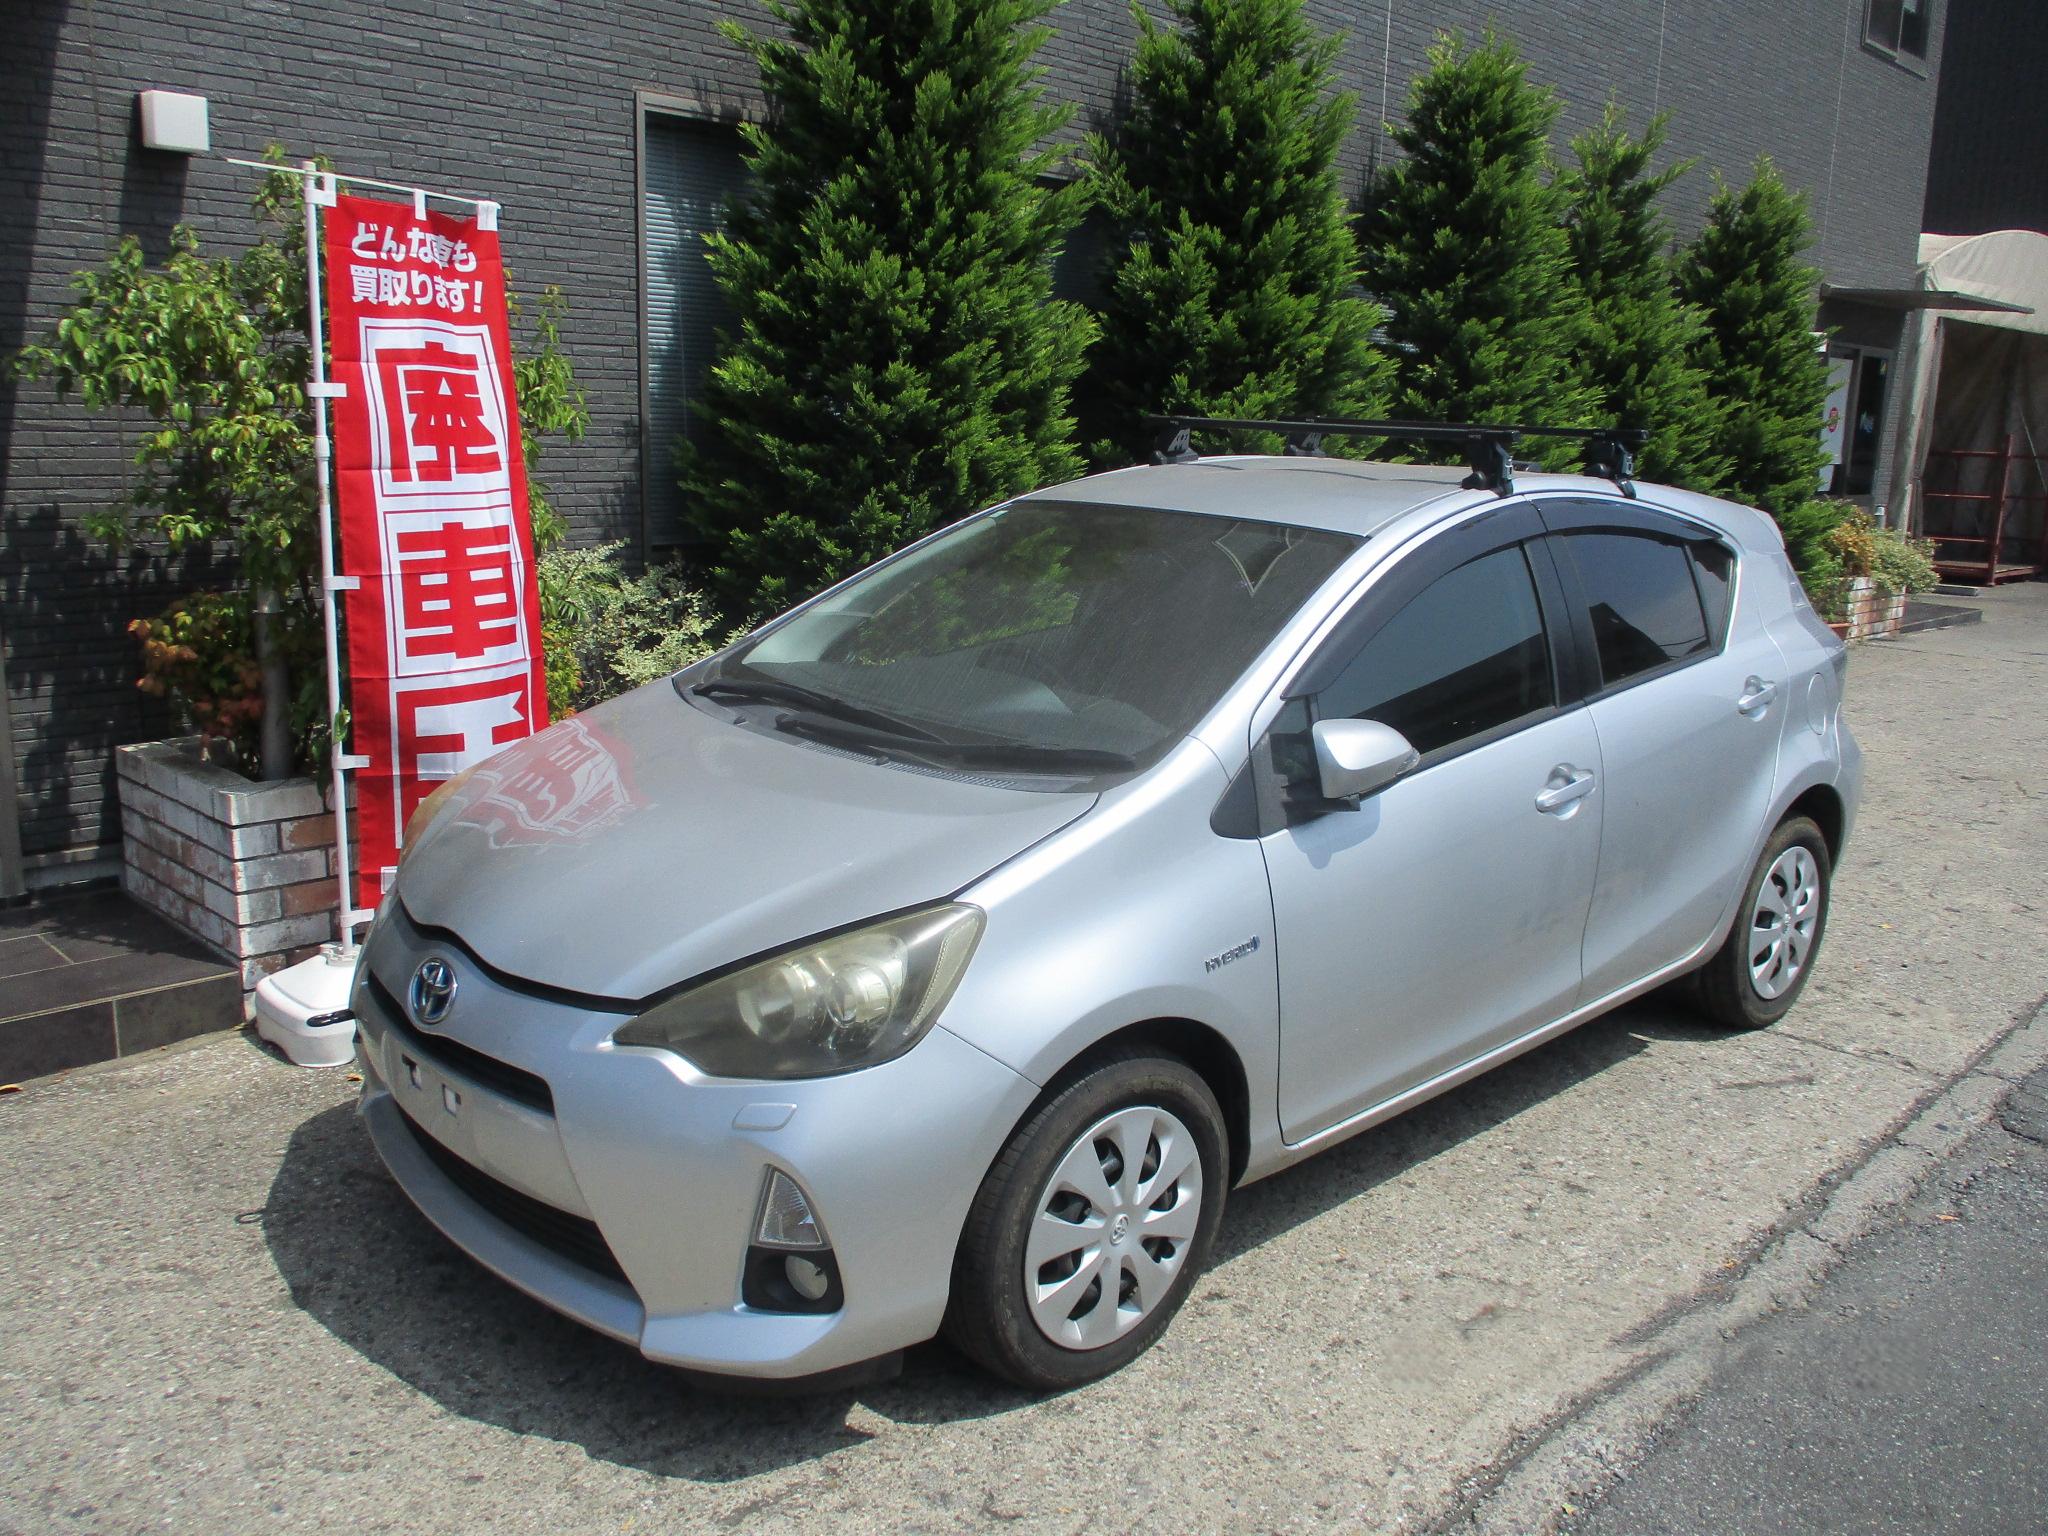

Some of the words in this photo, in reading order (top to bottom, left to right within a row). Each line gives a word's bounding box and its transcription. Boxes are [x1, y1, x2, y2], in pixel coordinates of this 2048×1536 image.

[350, 221, 478, 273] どんな車も
